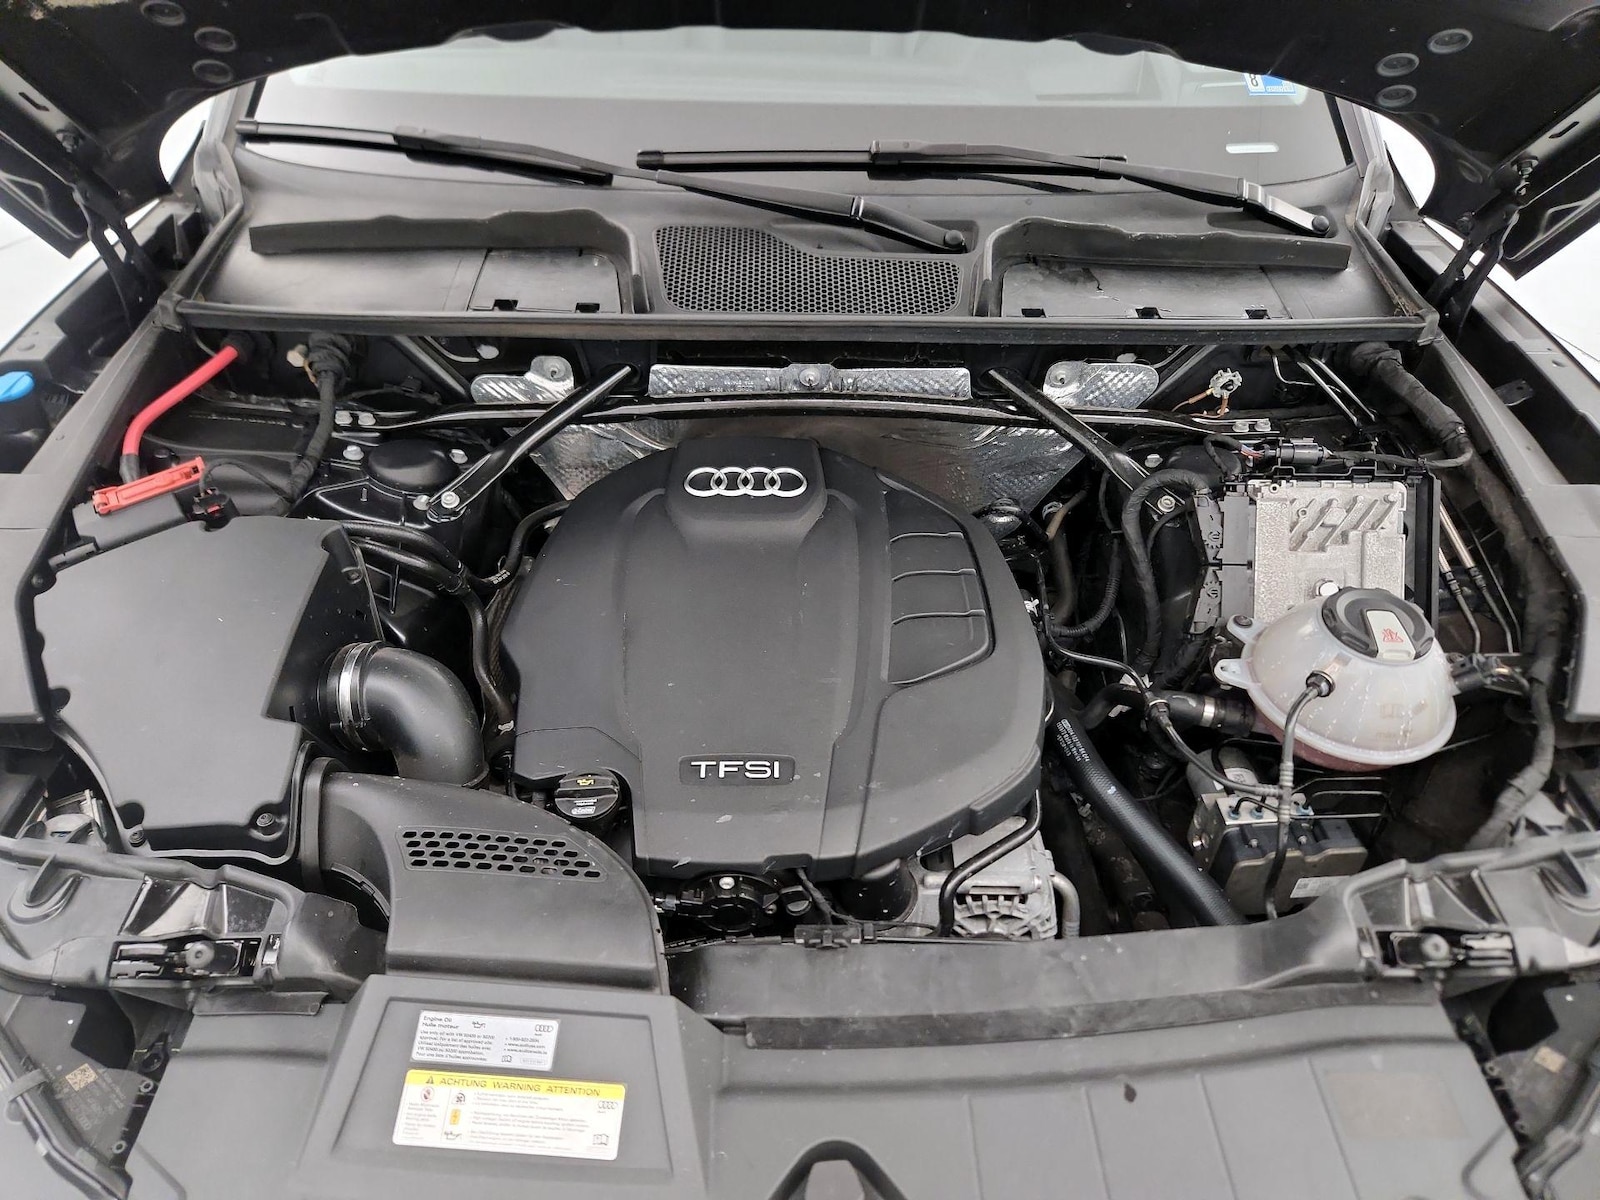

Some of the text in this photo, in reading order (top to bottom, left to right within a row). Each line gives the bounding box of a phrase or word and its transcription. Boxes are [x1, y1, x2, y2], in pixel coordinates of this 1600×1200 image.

[690, 761, 780, 779] TFSI
[439, 1077, 601, 1097] ACHTUNG WARNING ATTENTION
